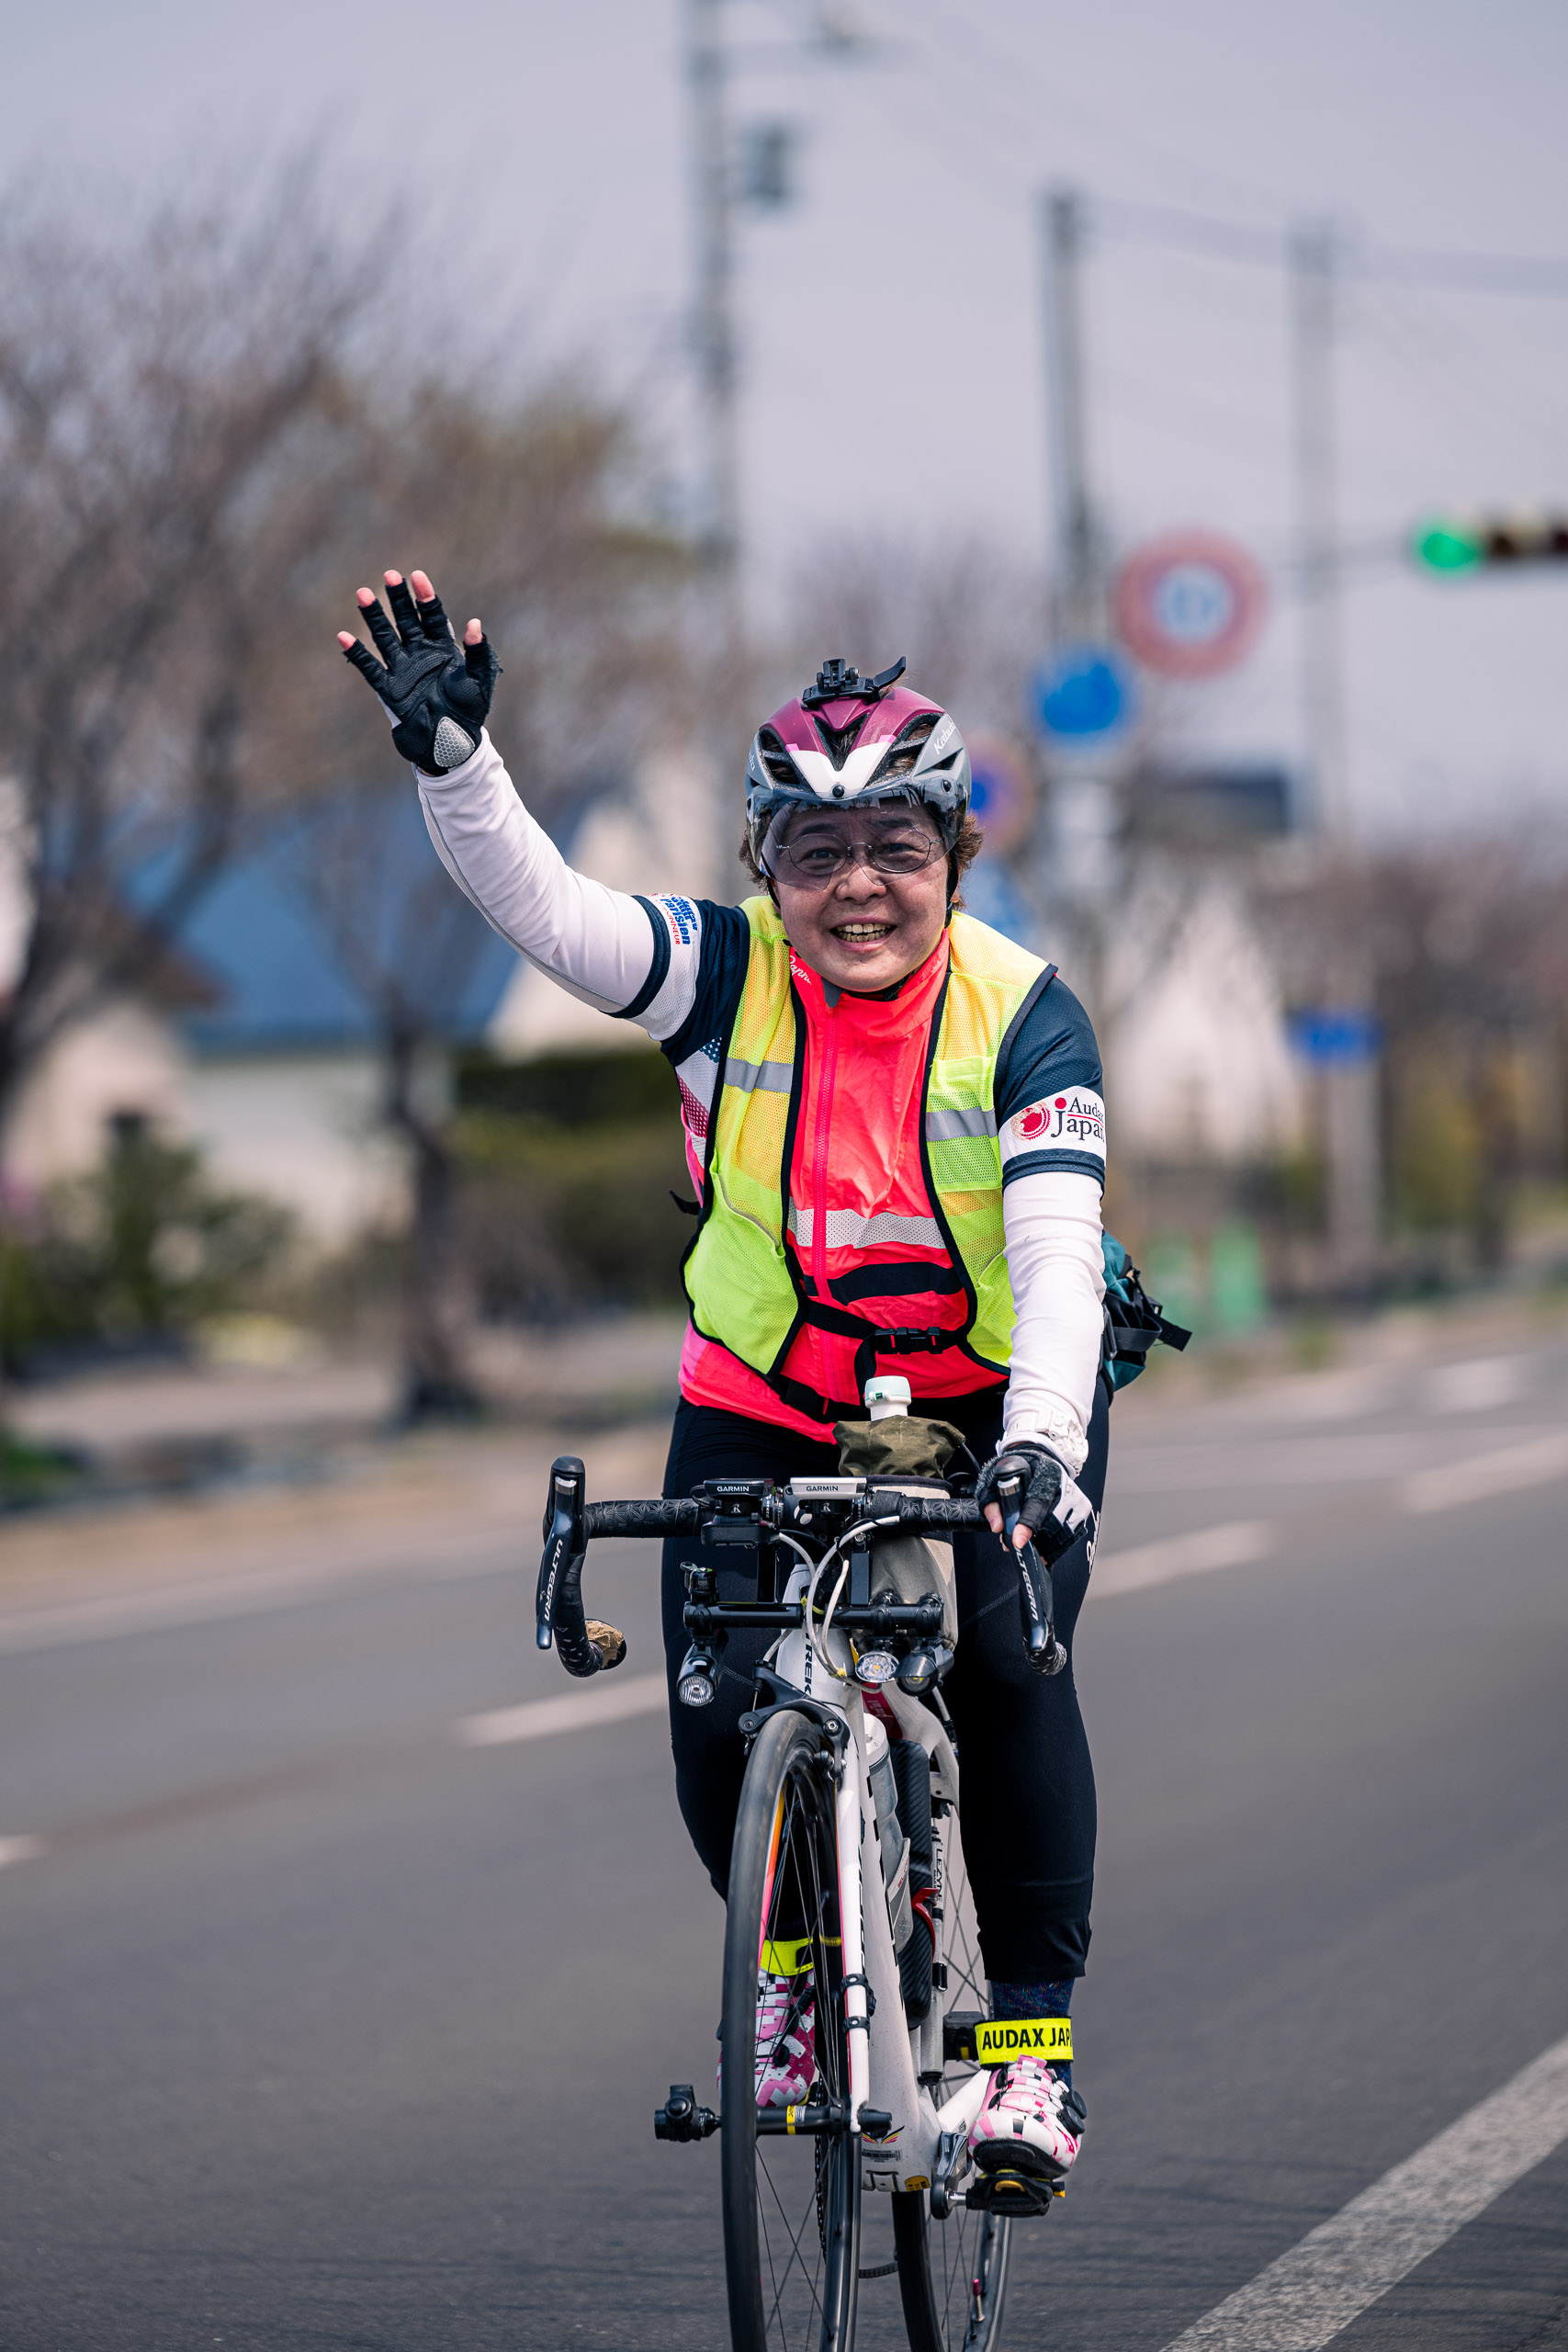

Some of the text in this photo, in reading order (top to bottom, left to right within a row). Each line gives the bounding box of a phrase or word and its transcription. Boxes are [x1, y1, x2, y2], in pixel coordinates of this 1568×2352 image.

[544, 1539, 563, 1622] ULTEGRA
[982, 2027, 1072, 2051] AUDAX JAP
